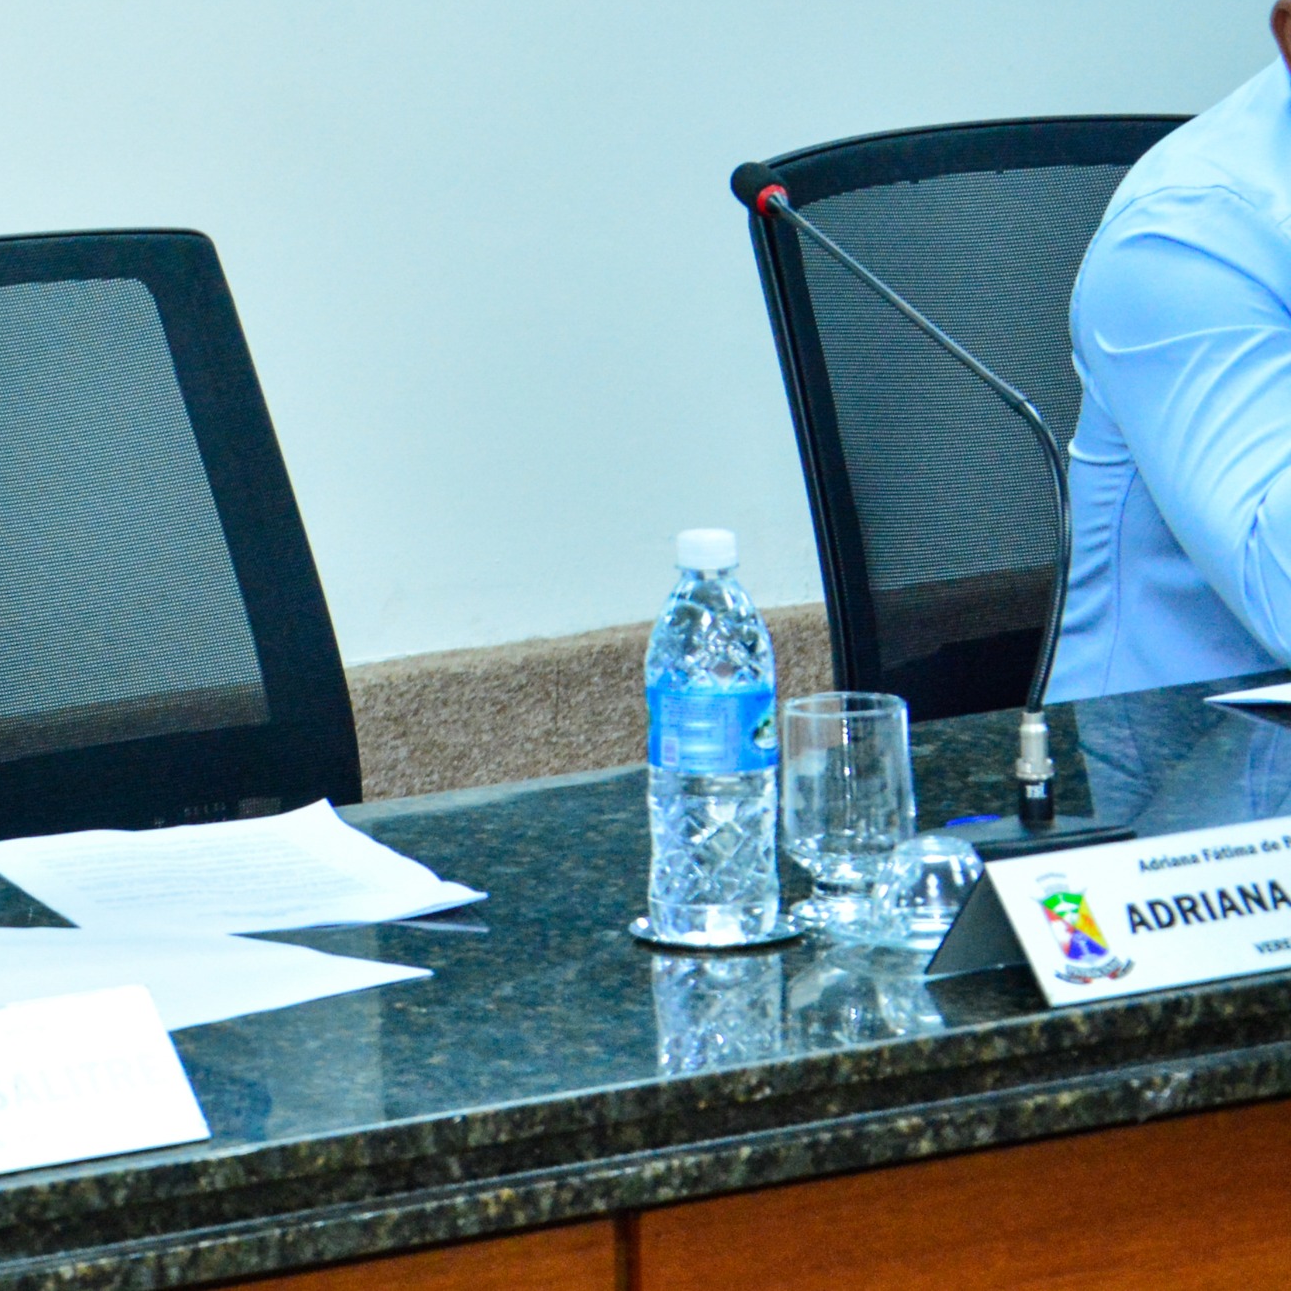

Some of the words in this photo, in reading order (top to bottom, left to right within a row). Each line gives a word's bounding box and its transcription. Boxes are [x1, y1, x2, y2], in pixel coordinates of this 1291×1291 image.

[1138, 854, 1200, 873] Adriana
[1202, 844, 1258, 862] Fátima
[1260, 838, 1281, 853] de
[1125, 879, 1291, 935] ADRIANA
